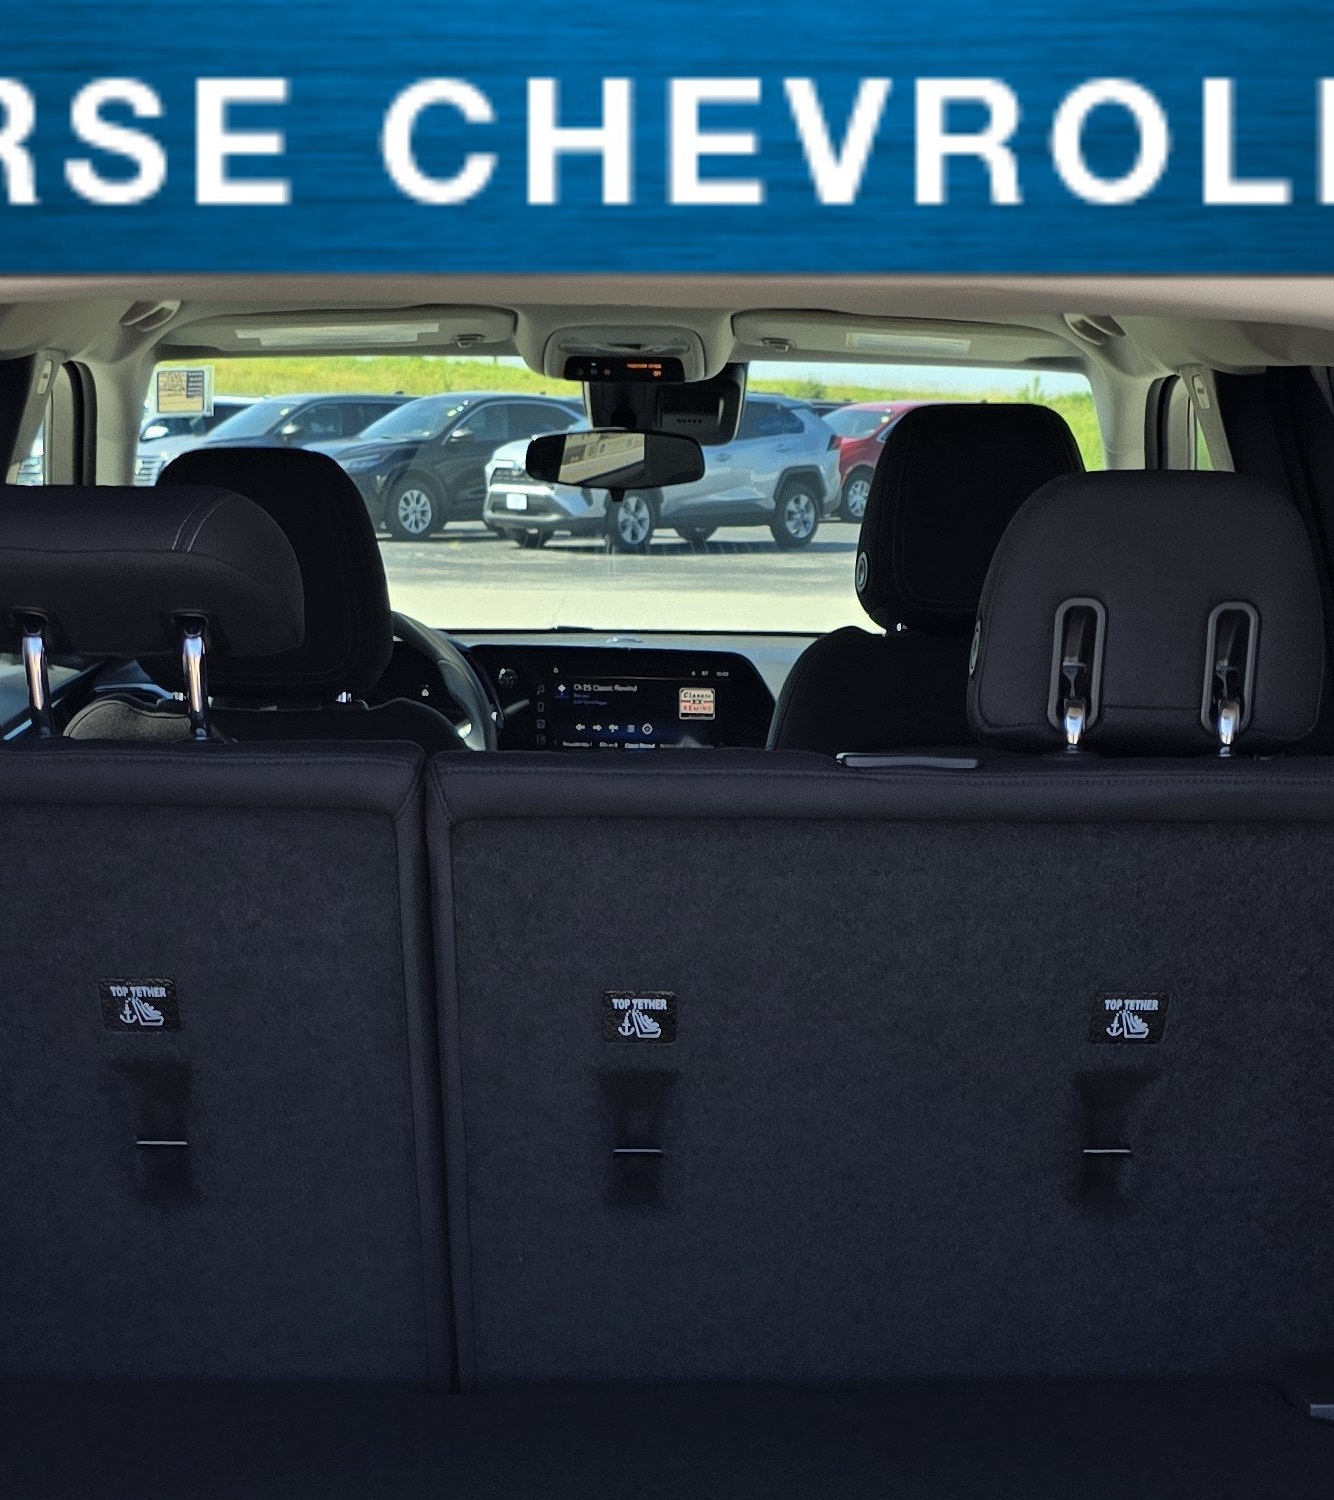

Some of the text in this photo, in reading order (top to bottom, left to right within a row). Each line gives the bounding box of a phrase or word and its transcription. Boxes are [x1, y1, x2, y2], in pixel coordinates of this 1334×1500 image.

[110, 985, 167, 998] TOP TETHER
[611, 998, 668, 1010] TOP TETHER
[1104, 998, 1159, 1011] TOP TETHER
